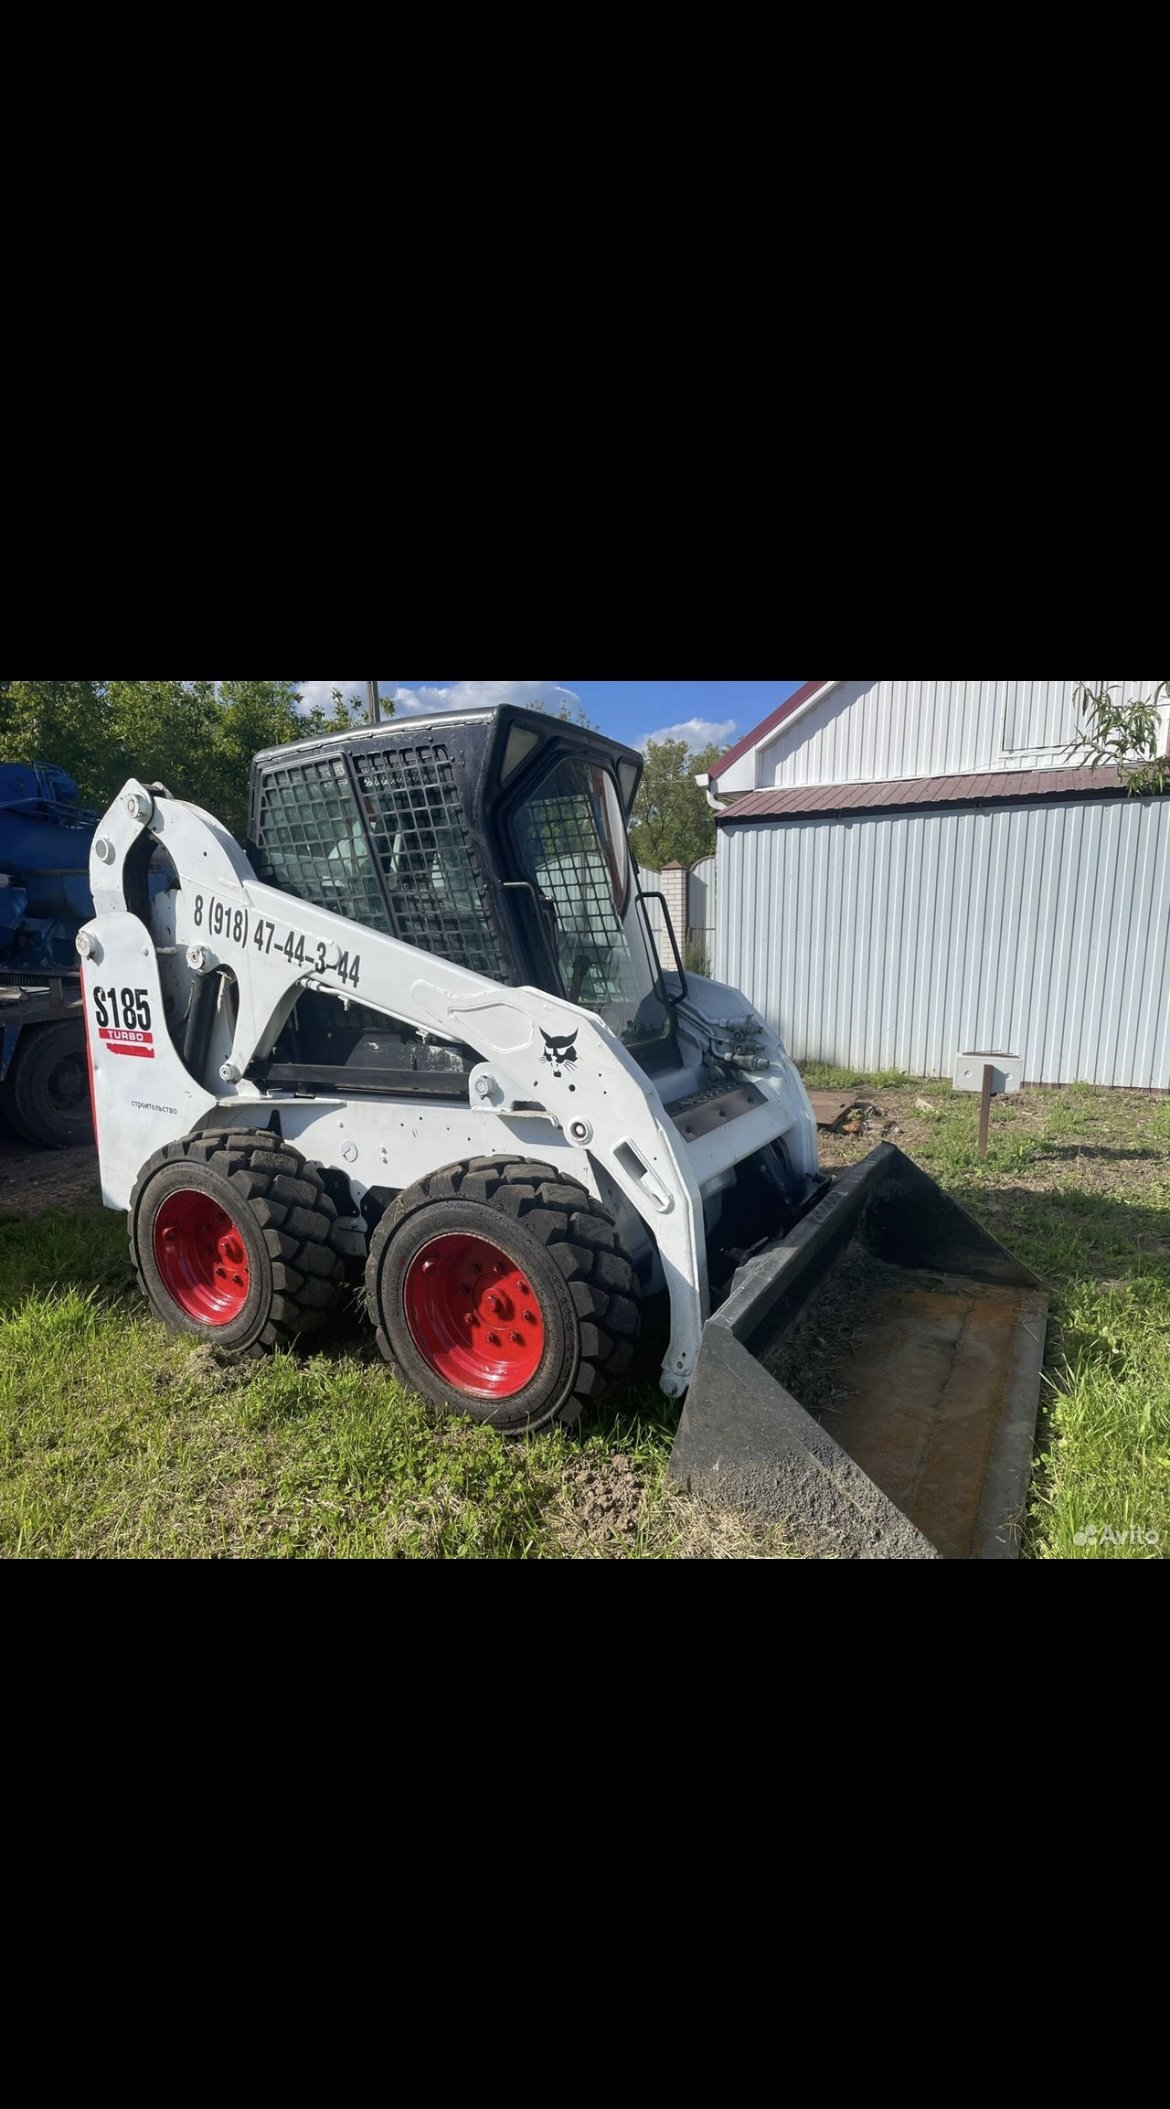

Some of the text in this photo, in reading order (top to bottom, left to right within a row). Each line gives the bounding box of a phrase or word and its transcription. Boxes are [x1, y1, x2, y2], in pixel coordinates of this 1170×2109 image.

[194, 895, 203, 926] 8
[208, 897, 248, 948] (918)
[93, 986, 152, 1031] S185
[107, 1030, 144, 1042] TURBO
[131, 1100, 178, 1115] строительство
